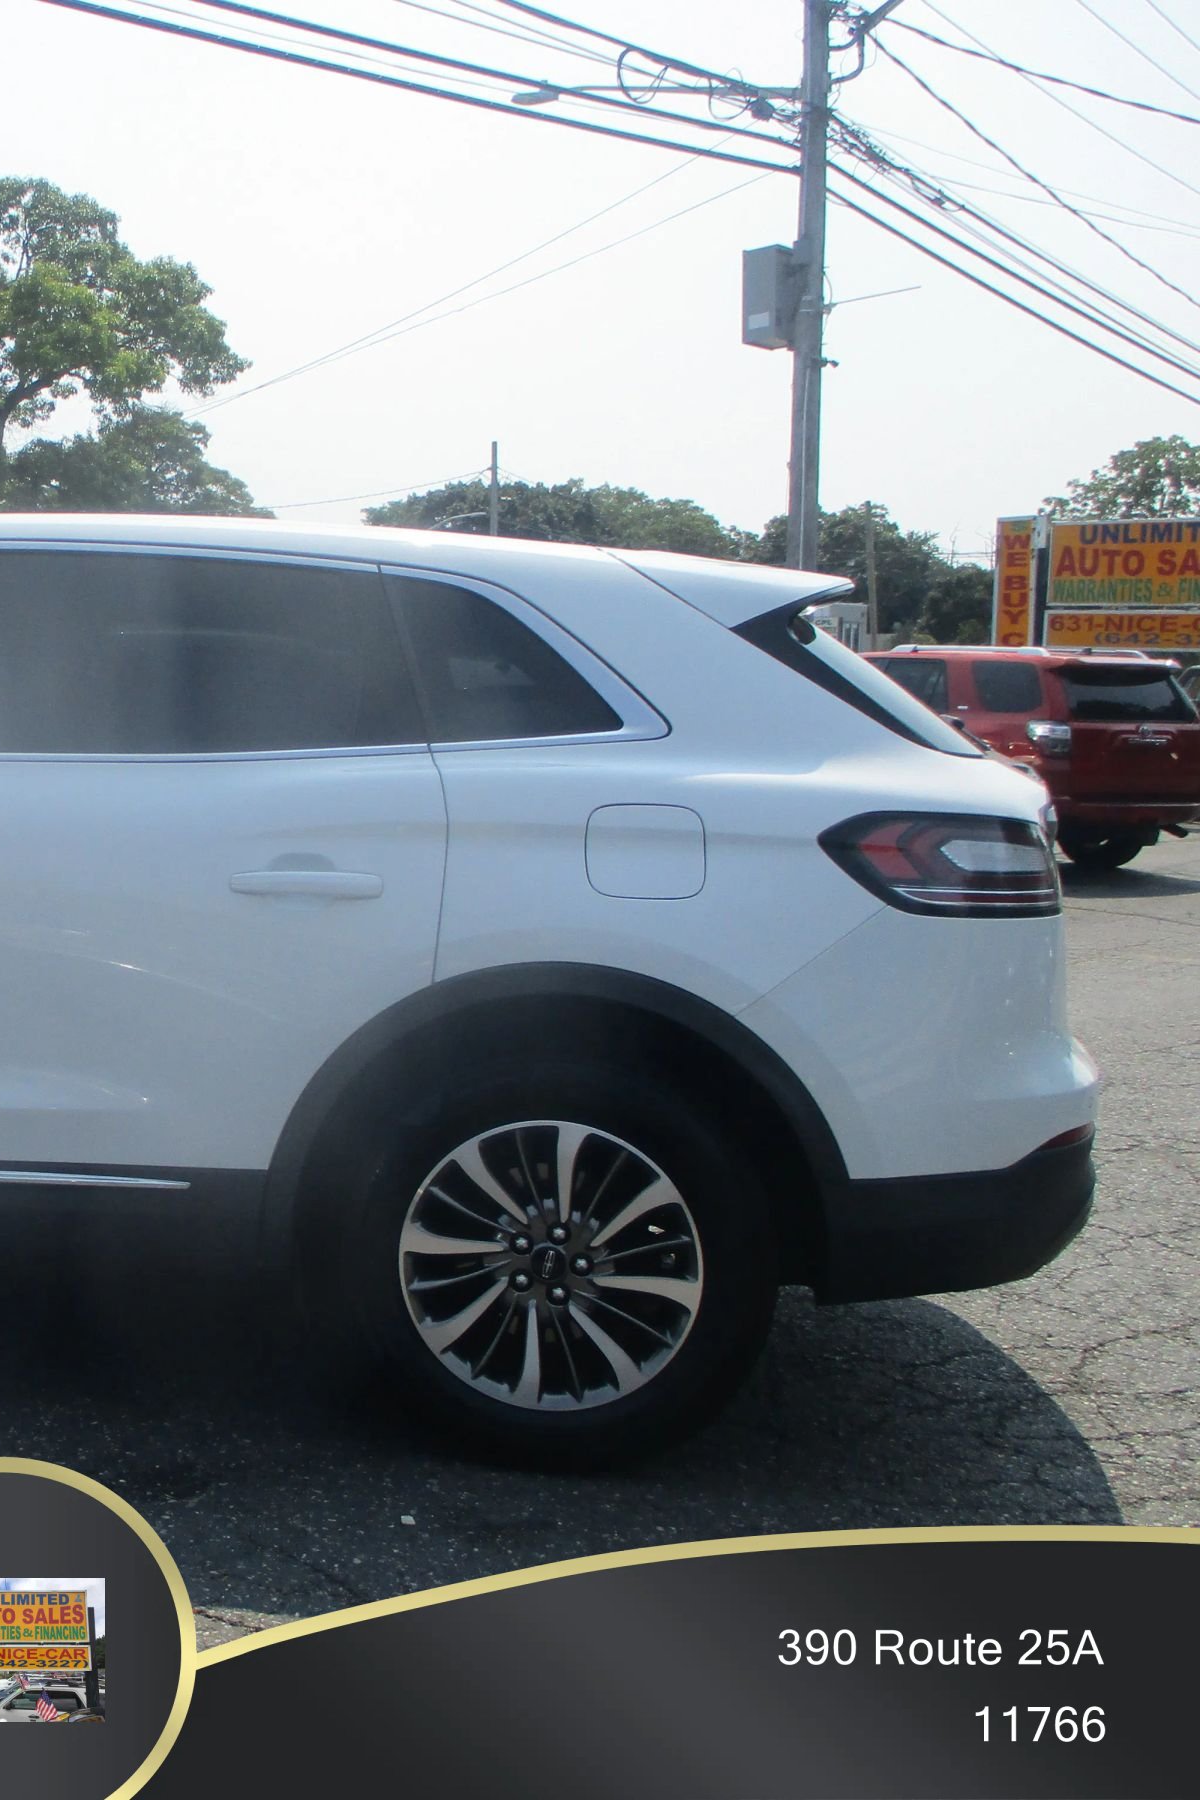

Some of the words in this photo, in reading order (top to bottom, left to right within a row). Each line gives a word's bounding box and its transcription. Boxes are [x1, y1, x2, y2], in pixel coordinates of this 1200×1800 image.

[1055, 546, 1145, 577] AUTO
[1053, 578, 1153, 603] WARRANTIES
[1157, 582, 1171, 598] &
